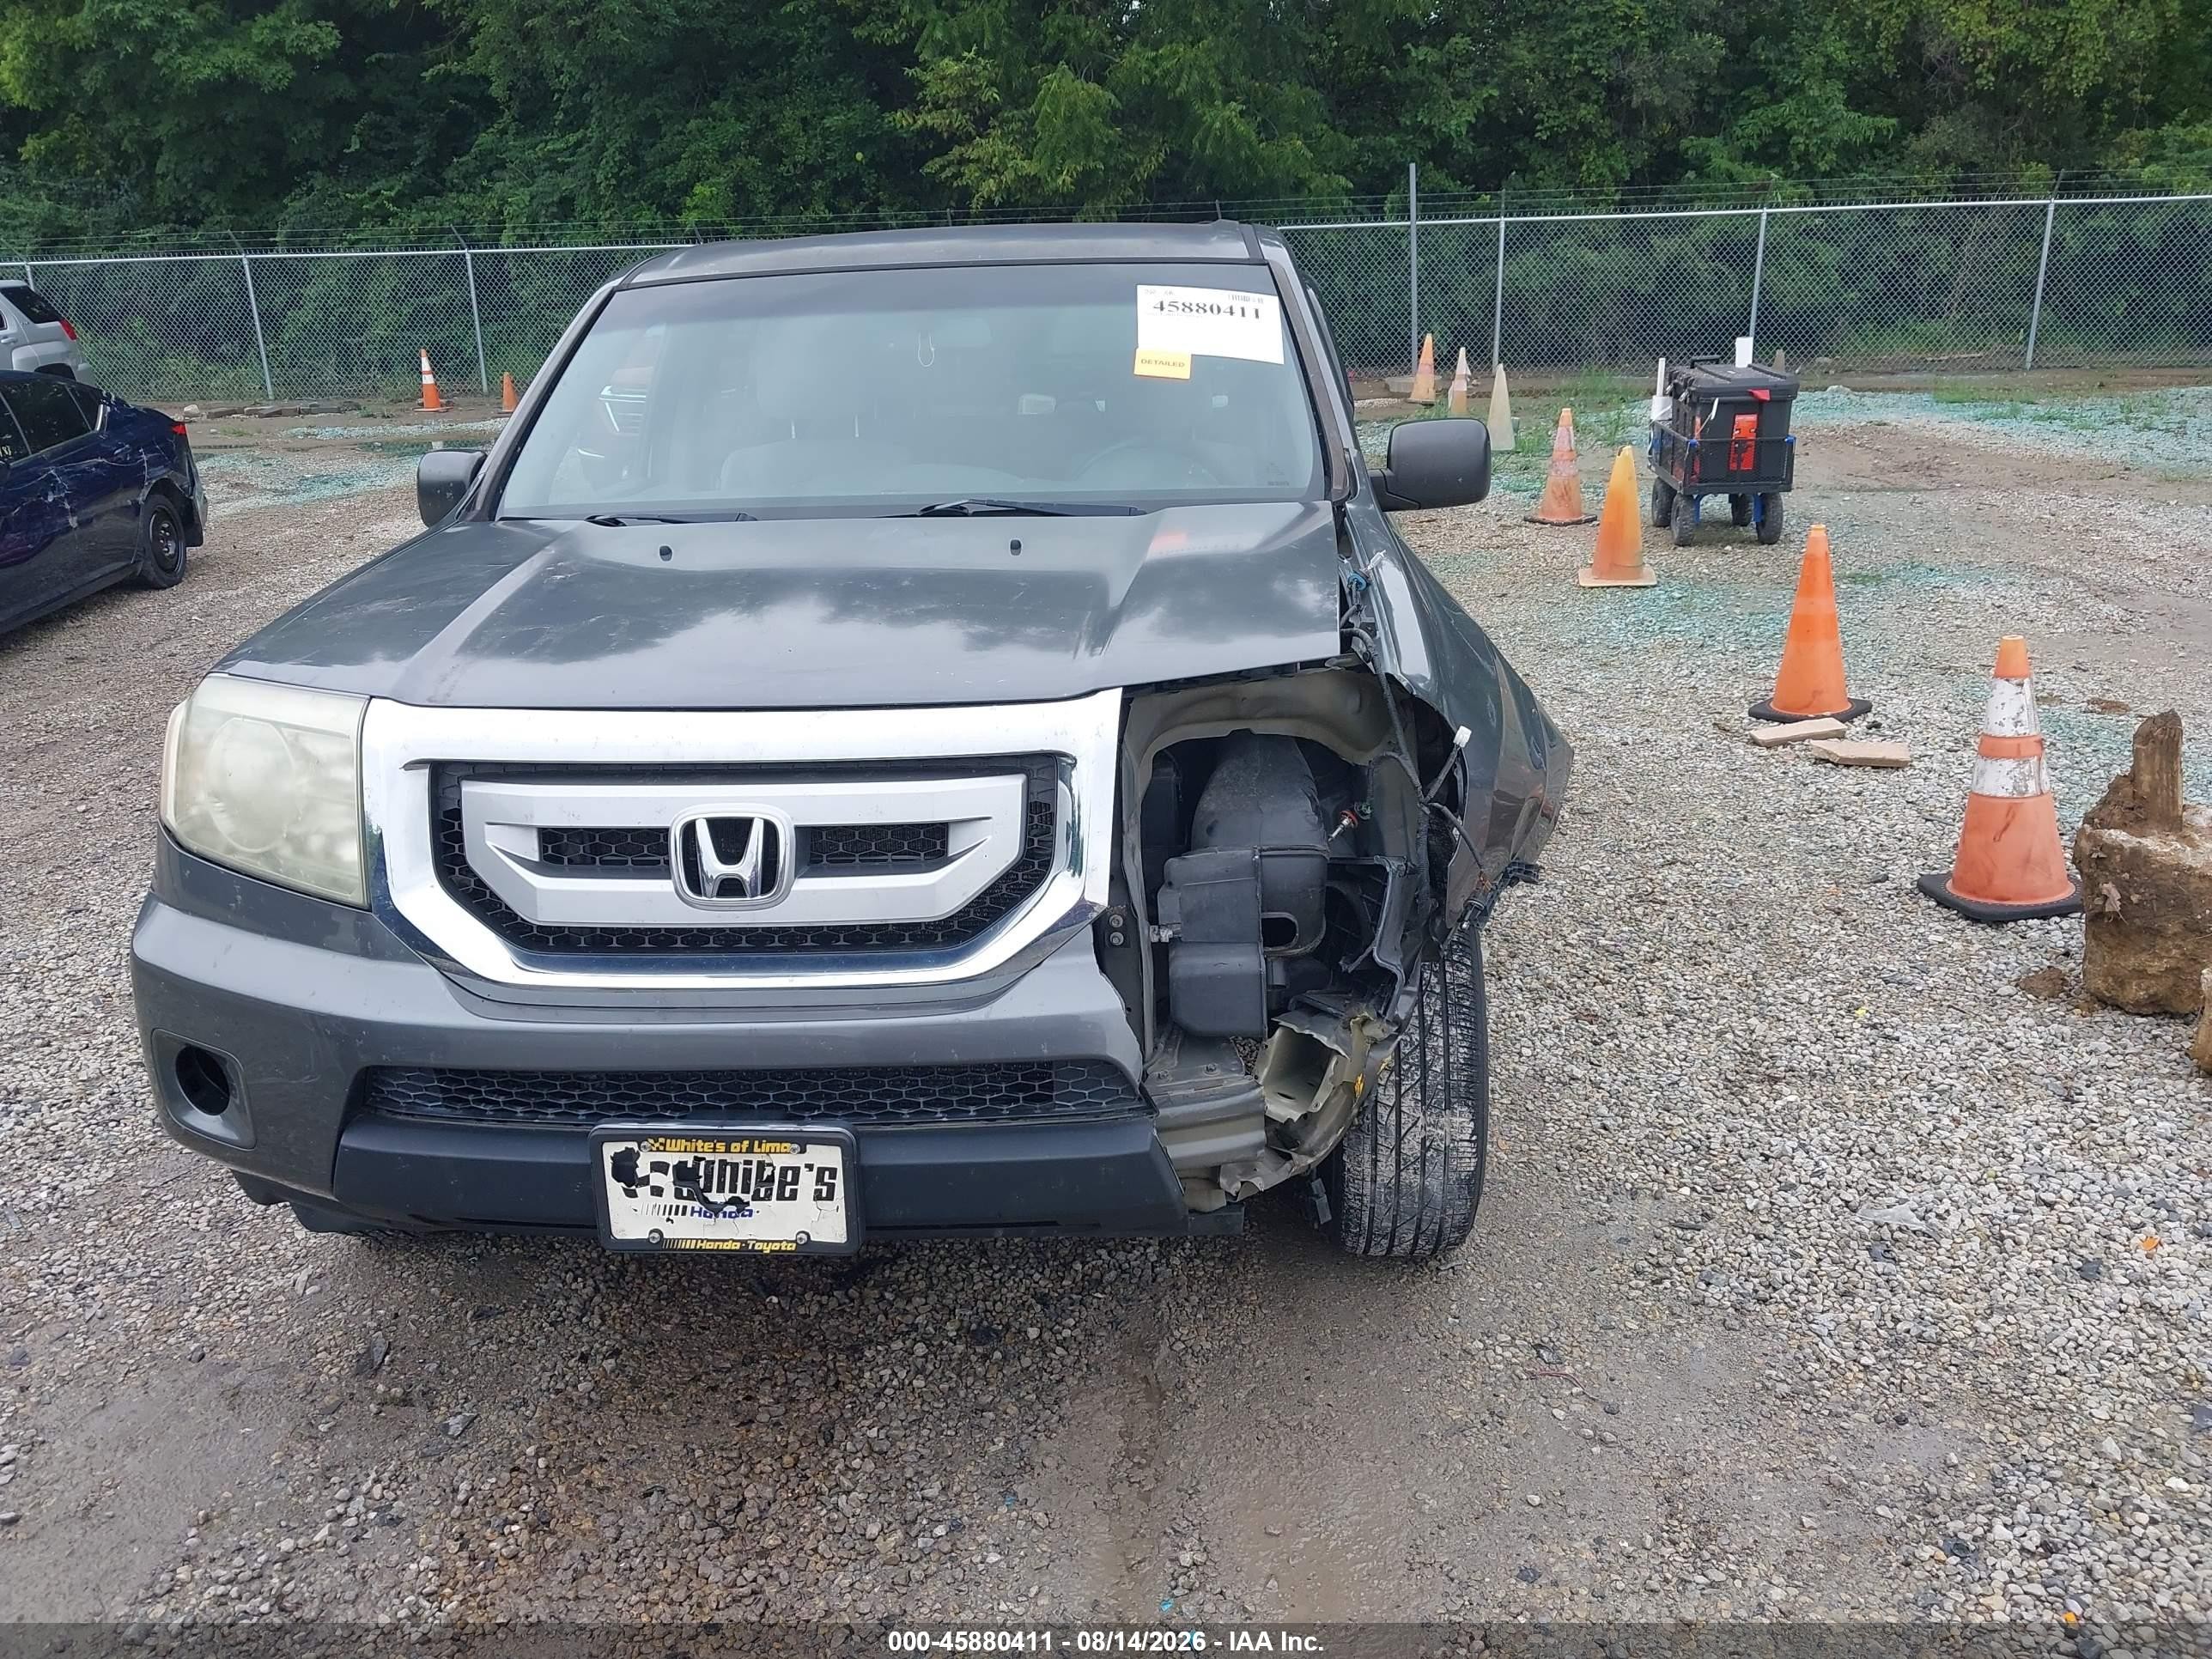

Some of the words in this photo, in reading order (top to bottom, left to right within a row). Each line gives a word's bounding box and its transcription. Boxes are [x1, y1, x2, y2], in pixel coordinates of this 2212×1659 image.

[1153, 300, 1260, 319] 45880411
[1140, 358, 1185, 368] DETAILED
[665, 1139, 726, 1152] White's
[731, 1140, 750, 1153] of
[753, 1139, 791, 1154] Lima
